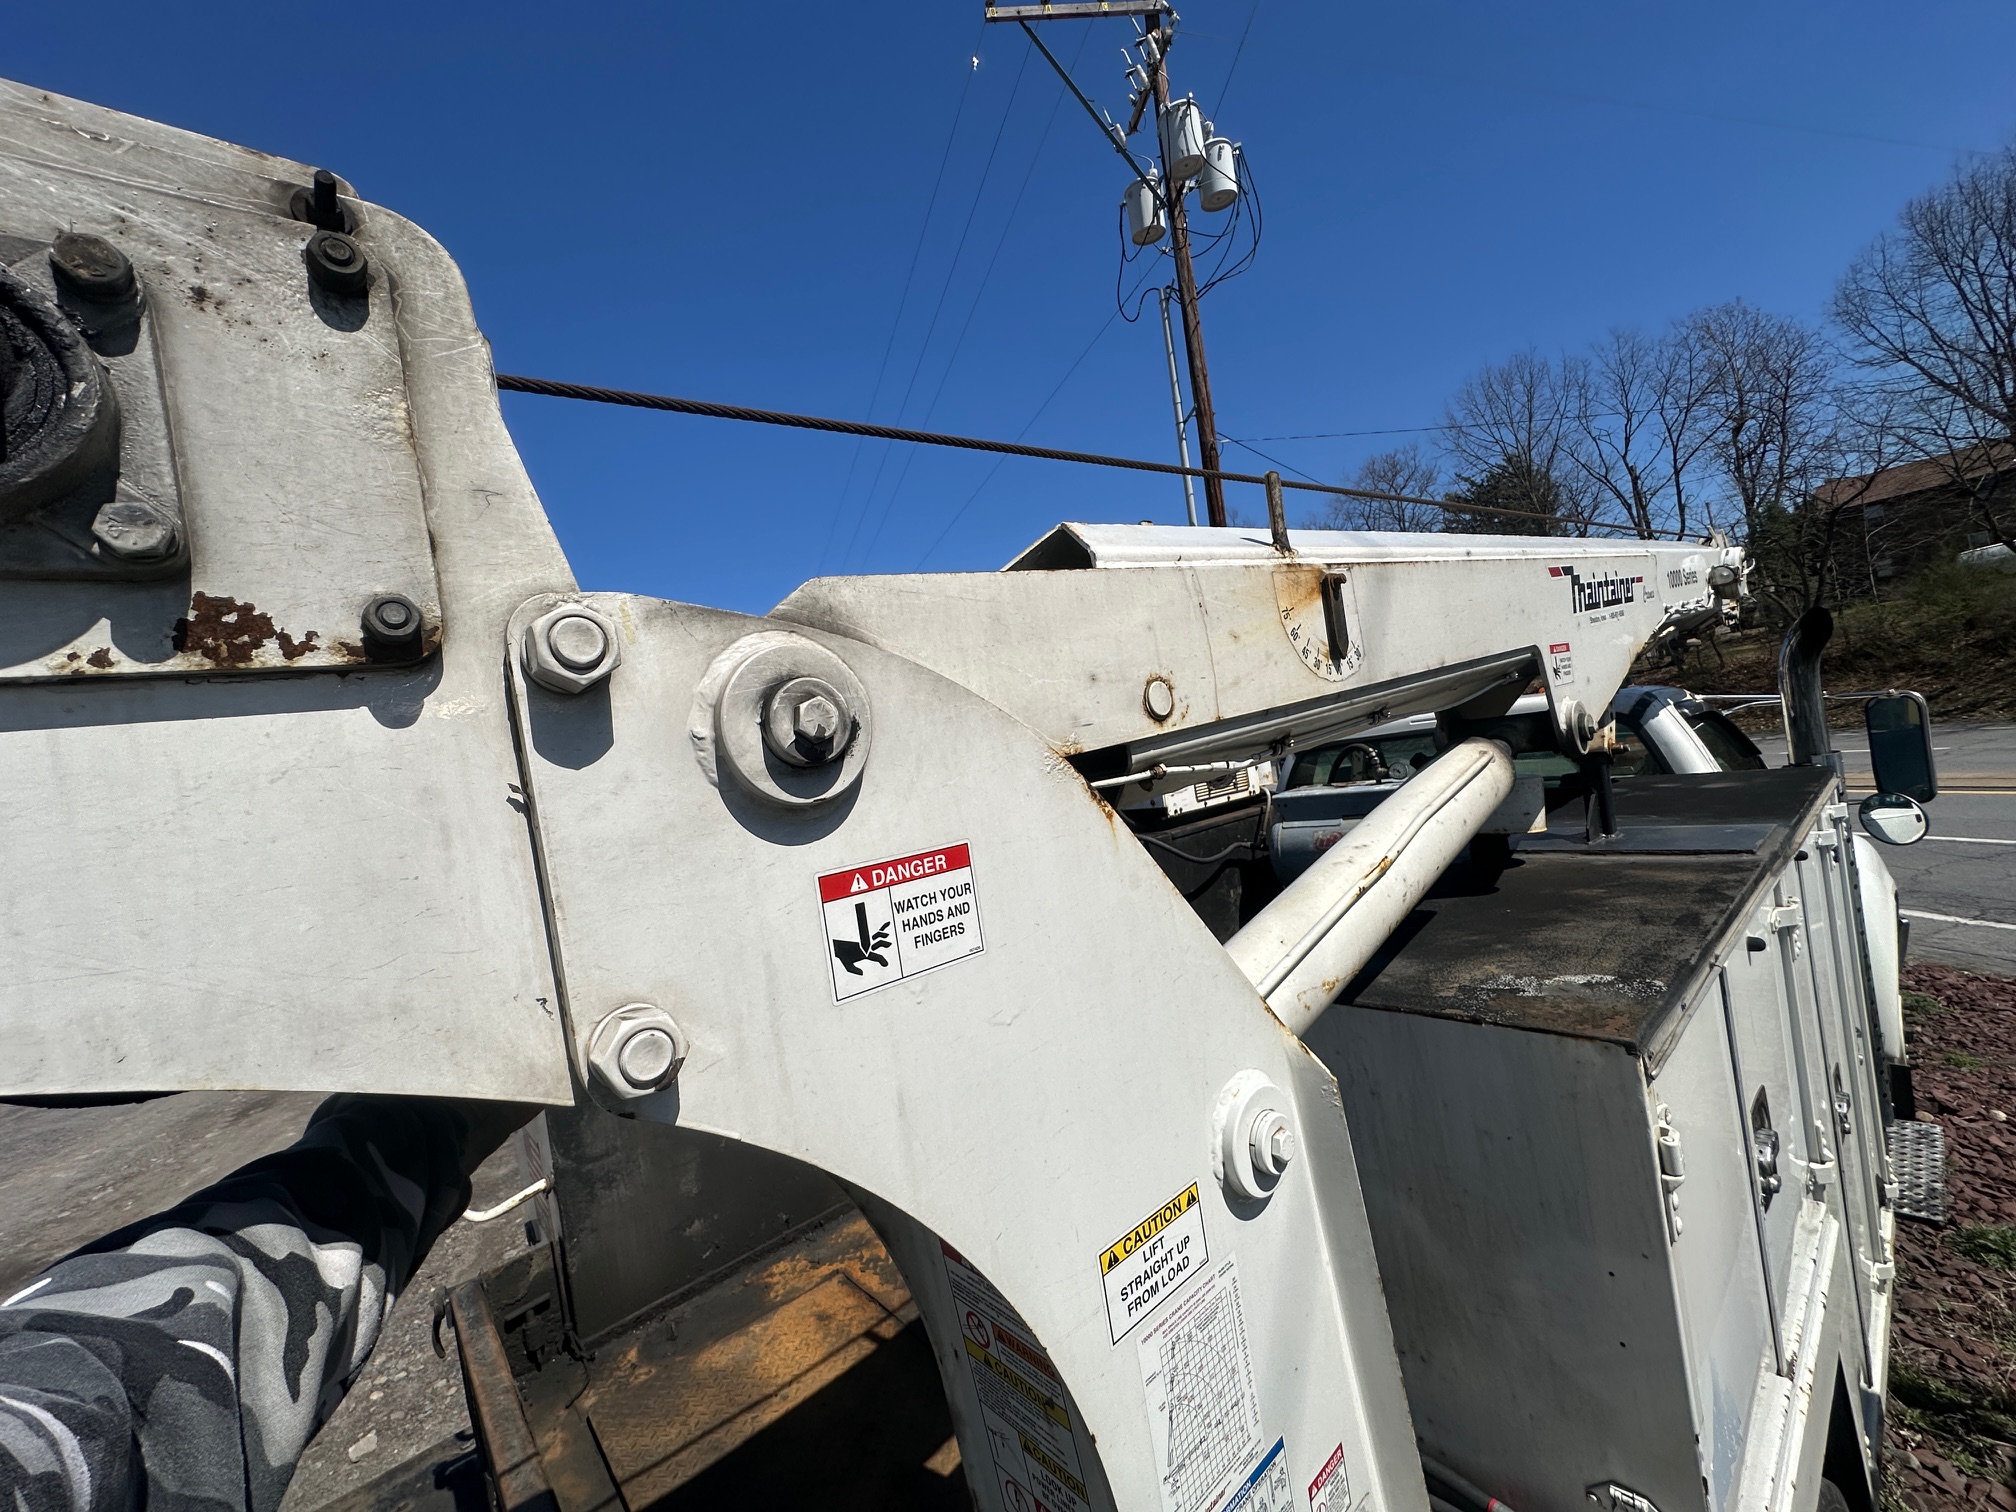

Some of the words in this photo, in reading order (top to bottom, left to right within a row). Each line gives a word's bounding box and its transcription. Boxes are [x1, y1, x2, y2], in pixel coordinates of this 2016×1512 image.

[1561, 566, 1635, 614] Maintainer
[1667, 569, 1683, 589] 10000
[1683, 568, 1698, 586] Series
[872, 854, 947, 887] DANGER
[894, 891, 937, 915] WATCH
[939, 882, 972, 901] YOUR
[902, 911, 944, 932] HANDS
[947, 902, 971, 920] AND
[914, 922, 965, 949] FINGERS
[1122, 1198, 1183, 1254] CAUTION
[1120, 1249, 1174, 1302] STRAIGHT
[1176, 1236, 1191, 1258] UP
[1142, 1235, 1165, 1264] LIFT
[1127, 1283, 1160, 1318] FROM
[1161, 1255, 1190, 1288] LOAD
[1153, 1317, 1169, 1334] SERIES
[1168, 1303, 1183, 1320] CRANE
[1183, 1287, 1203, 1306] CAPACITY
[1202, 1273, 1216, 1289] CHART
[1004, 1332, 1055, 1377] WARNING
[995, 1361, 1046, 1408] CAUTION
[1032, 1447, 1085, 1500] CAUTION
[1040, 1469, 1064, 1497] LOOK
[1065, 1491, 1077, 1506] UP
[1252, 1460, 1277, 1494] OPERATION
[1317, 1448, 1342, 1488] DANGER
